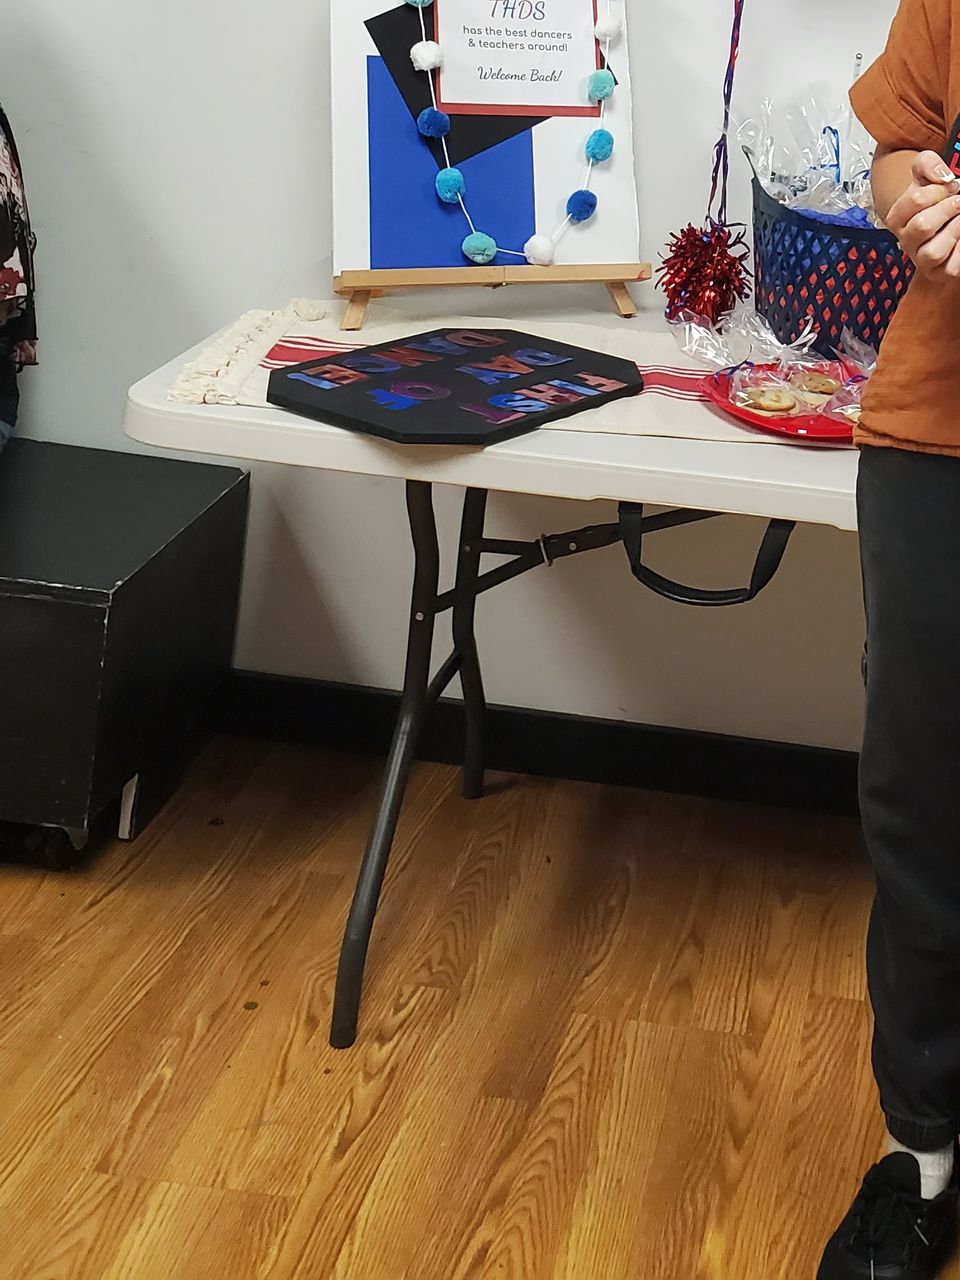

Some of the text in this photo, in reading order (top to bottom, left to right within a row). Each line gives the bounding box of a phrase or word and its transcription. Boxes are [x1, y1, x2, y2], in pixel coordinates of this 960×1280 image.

[463, 26, 573, 40] has the best dancers
[468, 38, 568, 52] & teachers around!
[477, 66, 563, 82] Welcome Back!
[455, 347, 573, 385] DAY
[459, 371, 628, 424] FIRST
